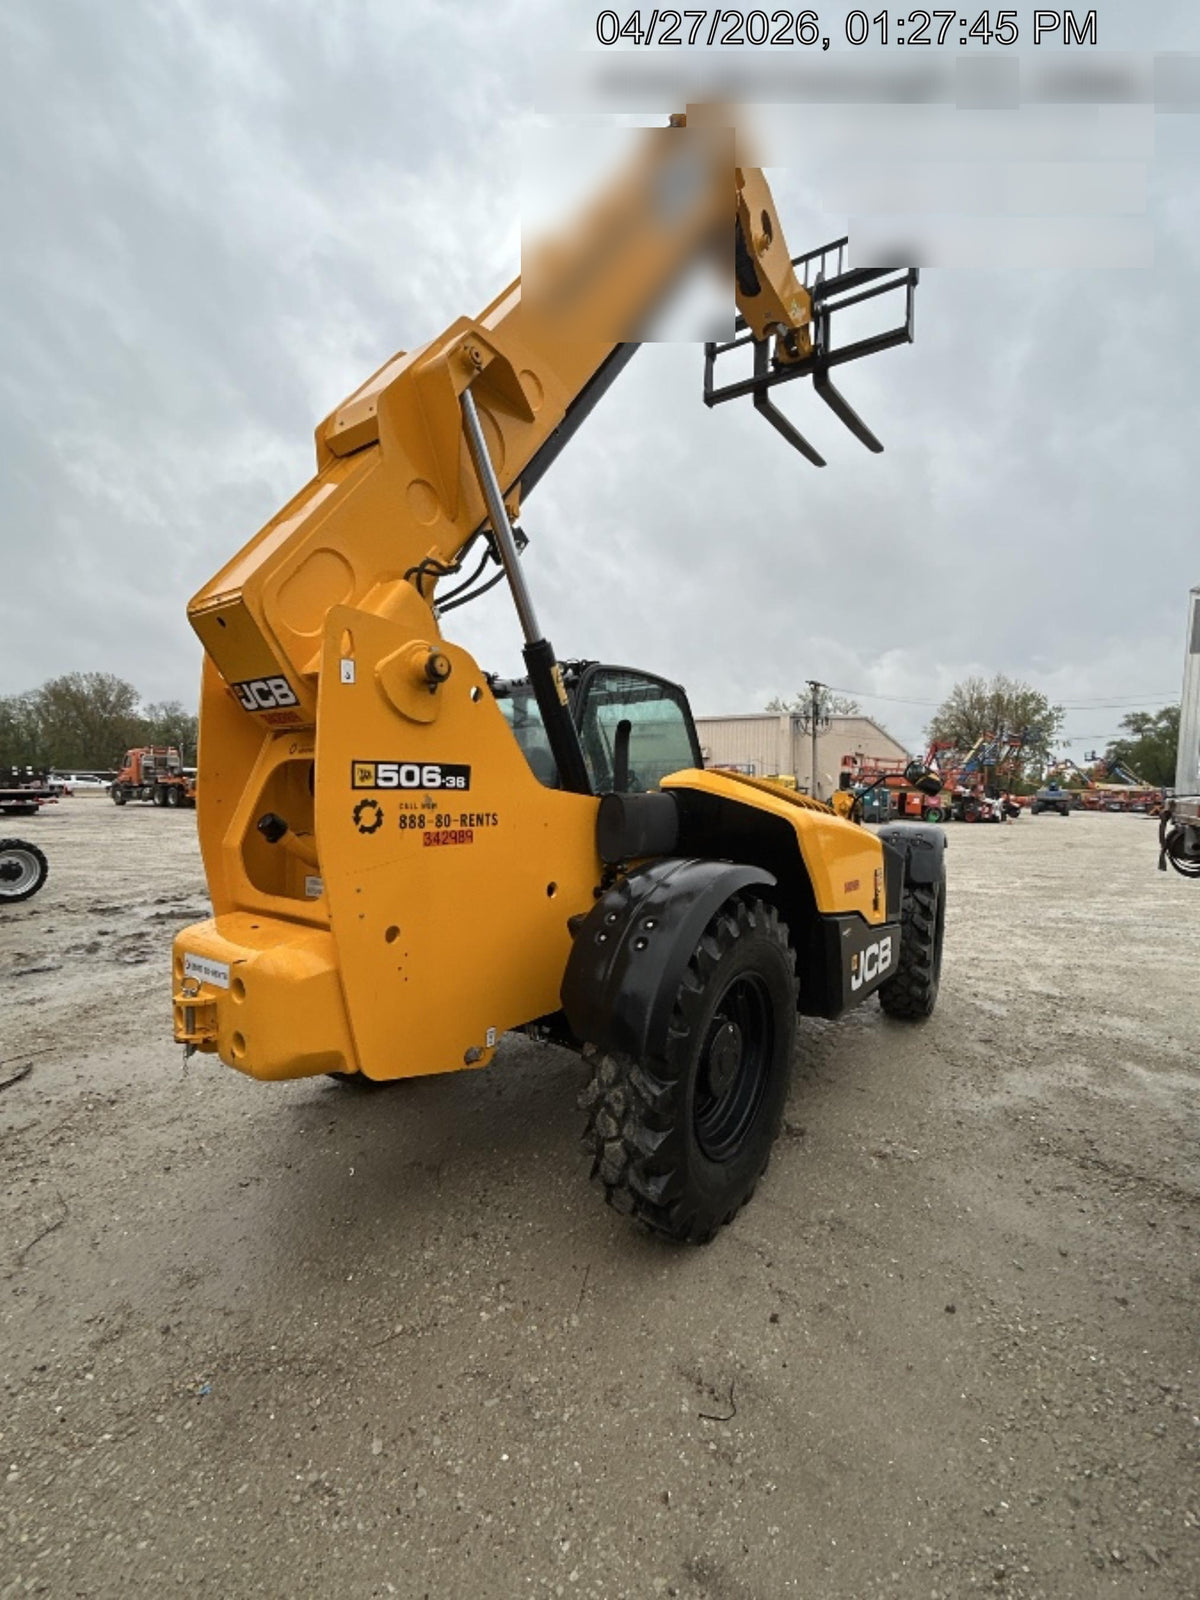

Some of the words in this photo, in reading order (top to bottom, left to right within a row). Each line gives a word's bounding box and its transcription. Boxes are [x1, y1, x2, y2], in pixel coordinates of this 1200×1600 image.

[241, 678, 298, 711] JCB
[399, 813, 499, 829] 888-80-RENTS
[851, 936, 892, 991] JCB
